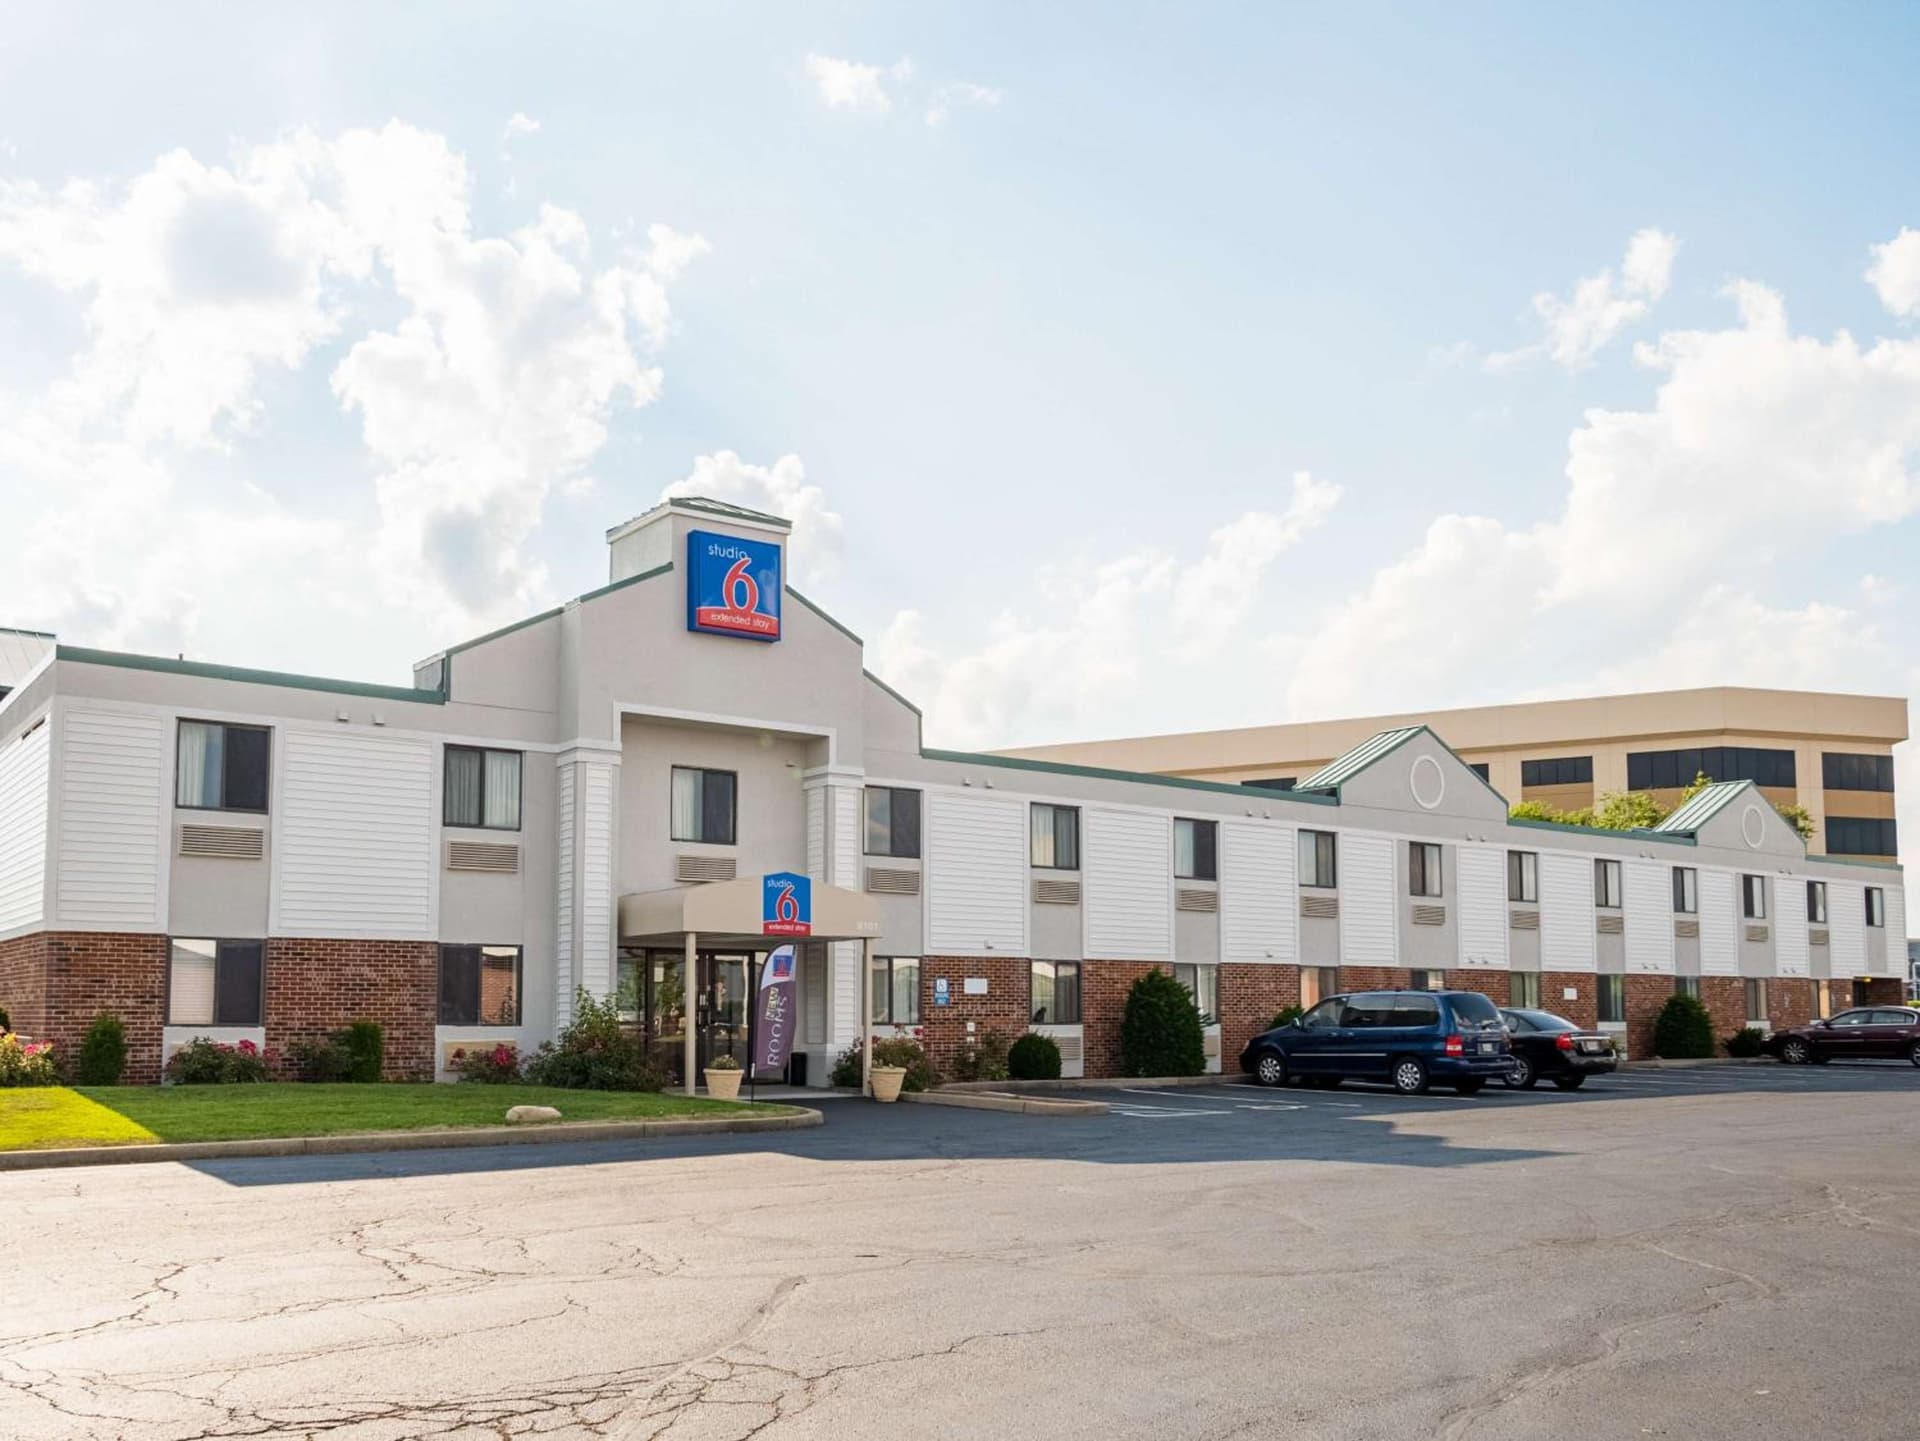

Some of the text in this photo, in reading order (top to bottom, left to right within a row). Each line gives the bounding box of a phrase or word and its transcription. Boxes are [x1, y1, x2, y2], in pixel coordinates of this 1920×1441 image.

[708, 544, 747, 559] studio
[723, 558, 759, 610] 6
[711, 613, 770, 630] extended stay
[767, 880, 792, 889] studio
[776, 885, 799, 921] 6
[765, 987, 779, 1021] NEW
[767, 996, 787, 1066] ROOMS
